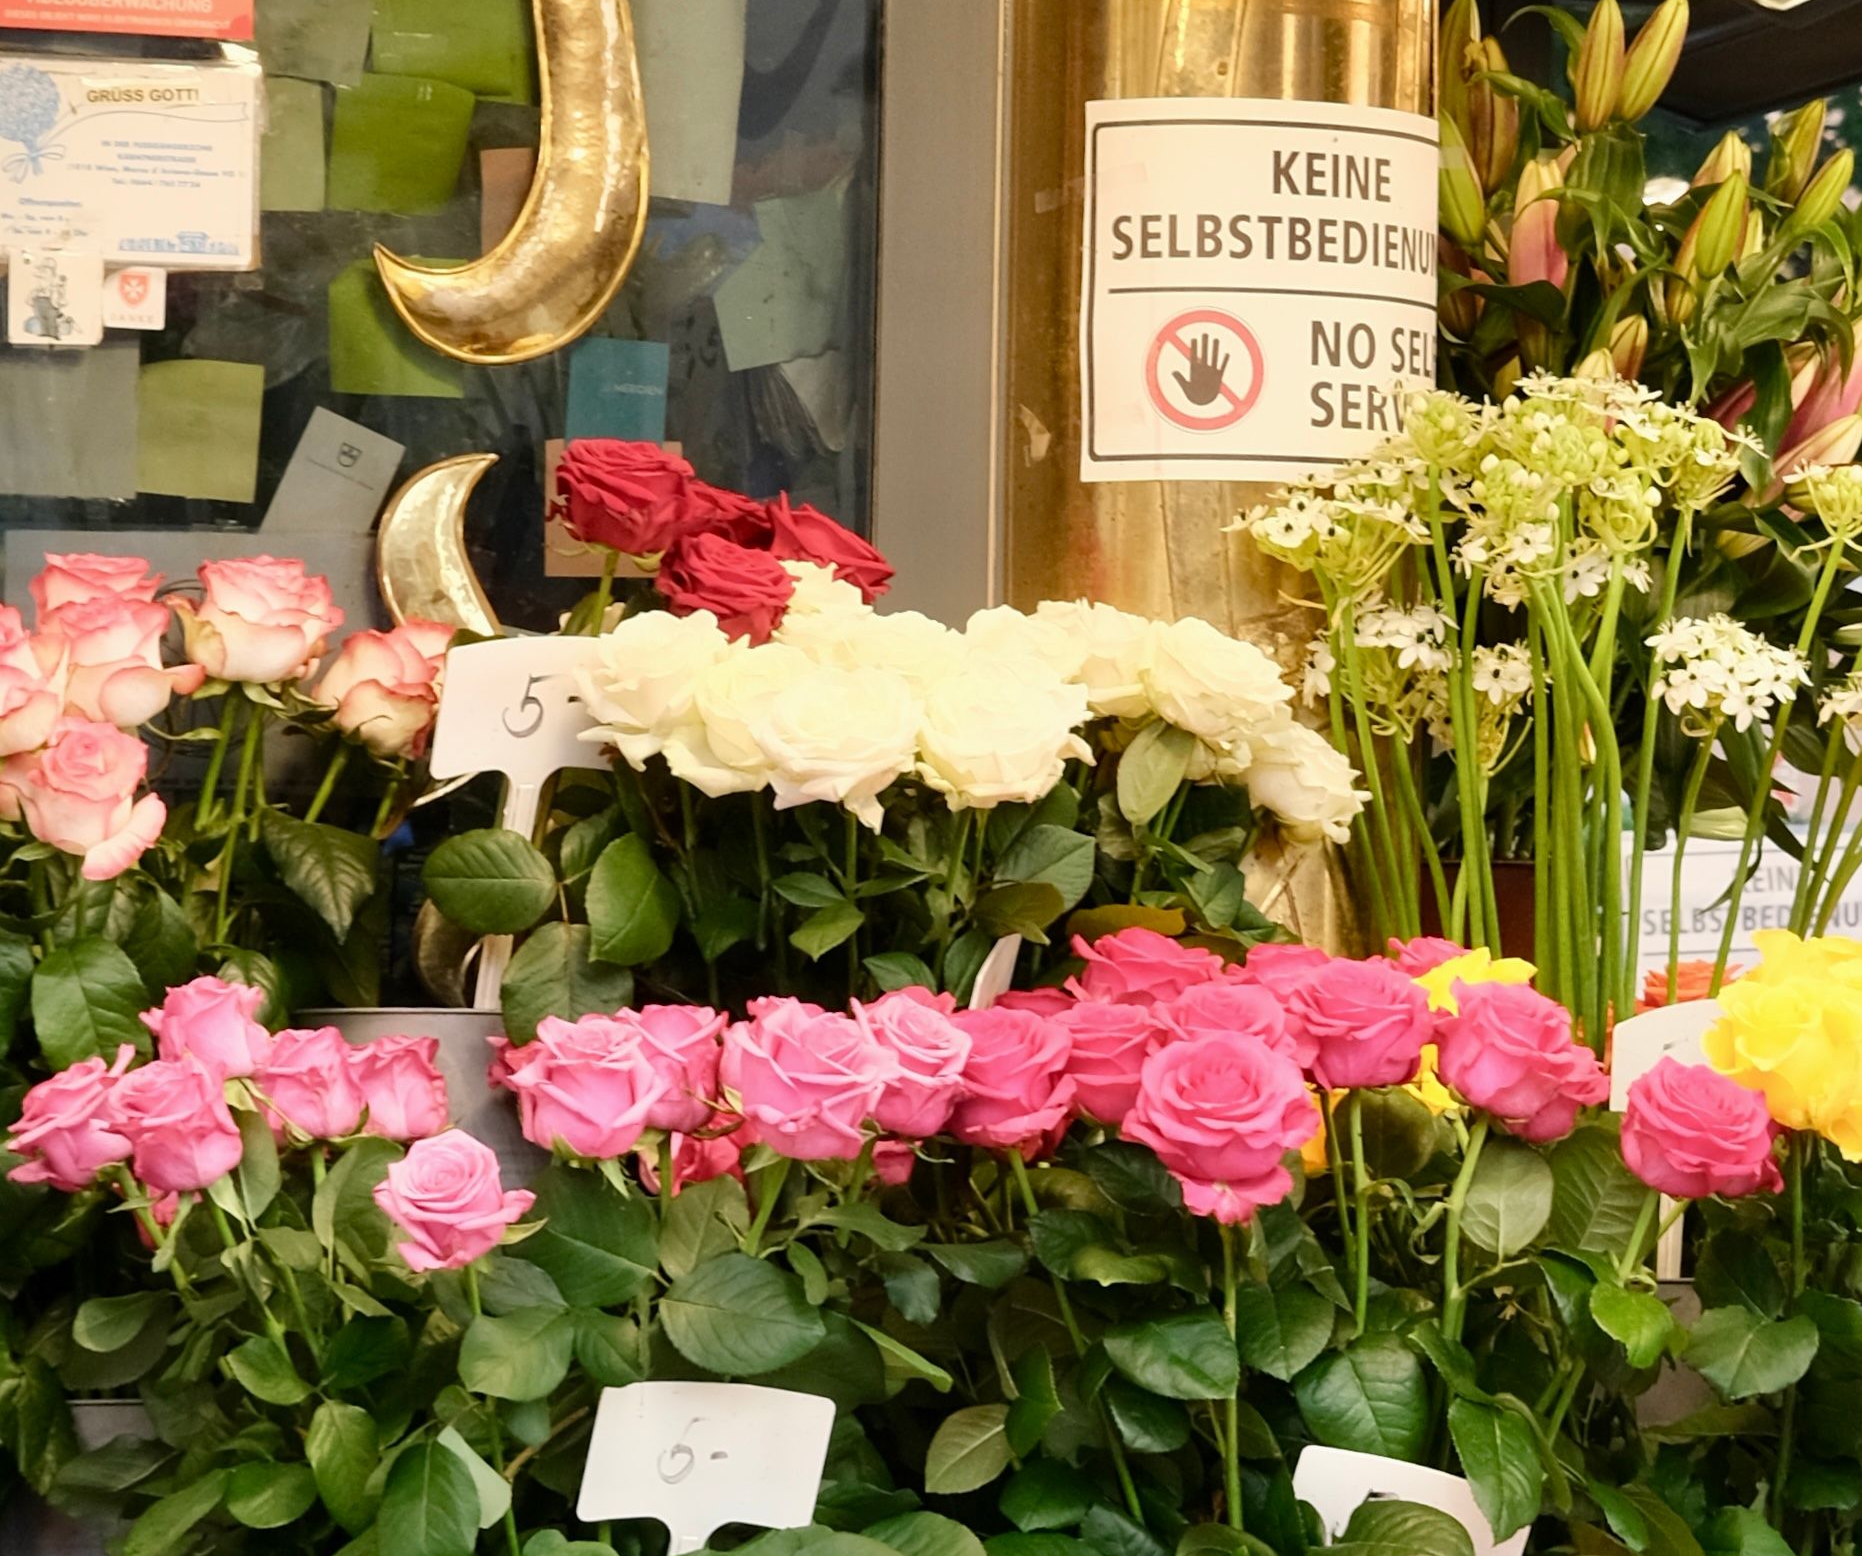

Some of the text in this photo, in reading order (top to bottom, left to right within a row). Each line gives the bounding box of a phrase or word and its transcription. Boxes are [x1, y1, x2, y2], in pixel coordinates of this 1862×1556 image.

[86, 85, 144, 103] GRÜSS
[1272, 150, 1392, 203] KEINE
[1311, 320, 1437, 379] NO SEL
[1732, 865, 1797, 893] EIN
